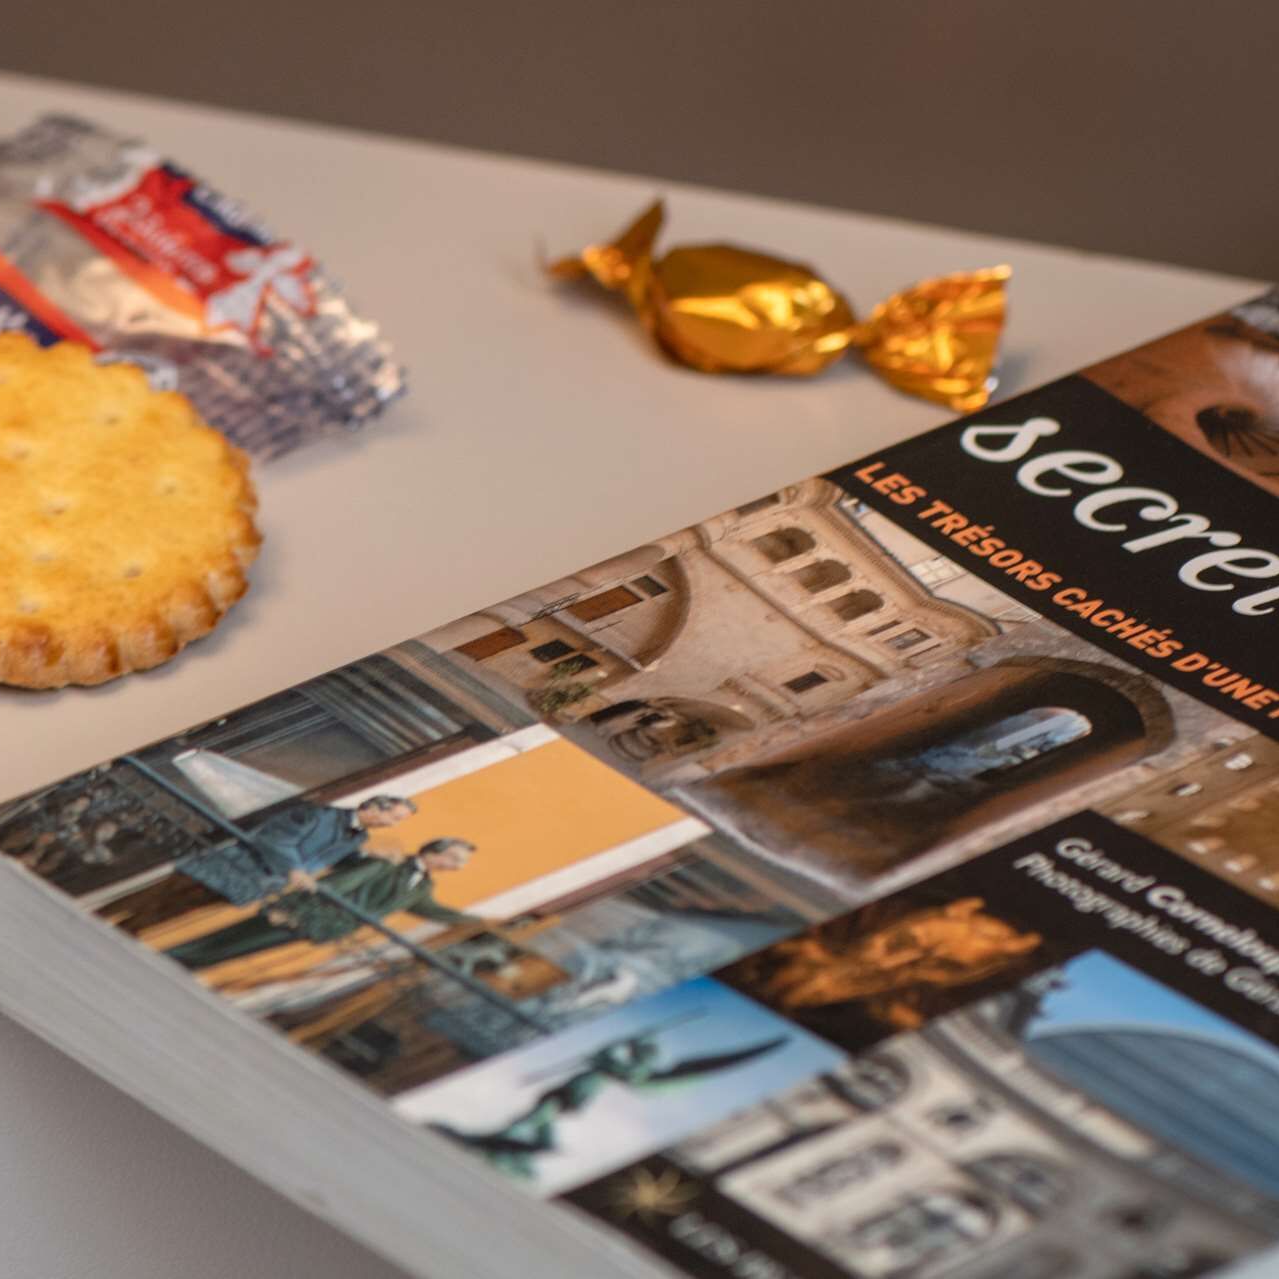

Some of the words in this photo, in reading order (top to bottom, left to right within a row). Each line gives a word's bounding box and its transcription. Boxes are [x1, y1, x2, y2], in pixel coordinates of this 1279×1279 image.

[853, 460, 923, 507] LES
[916, 497, 1062, 593] TRÉSORS
[1051, 585, 1184, 661] CACHÉS
